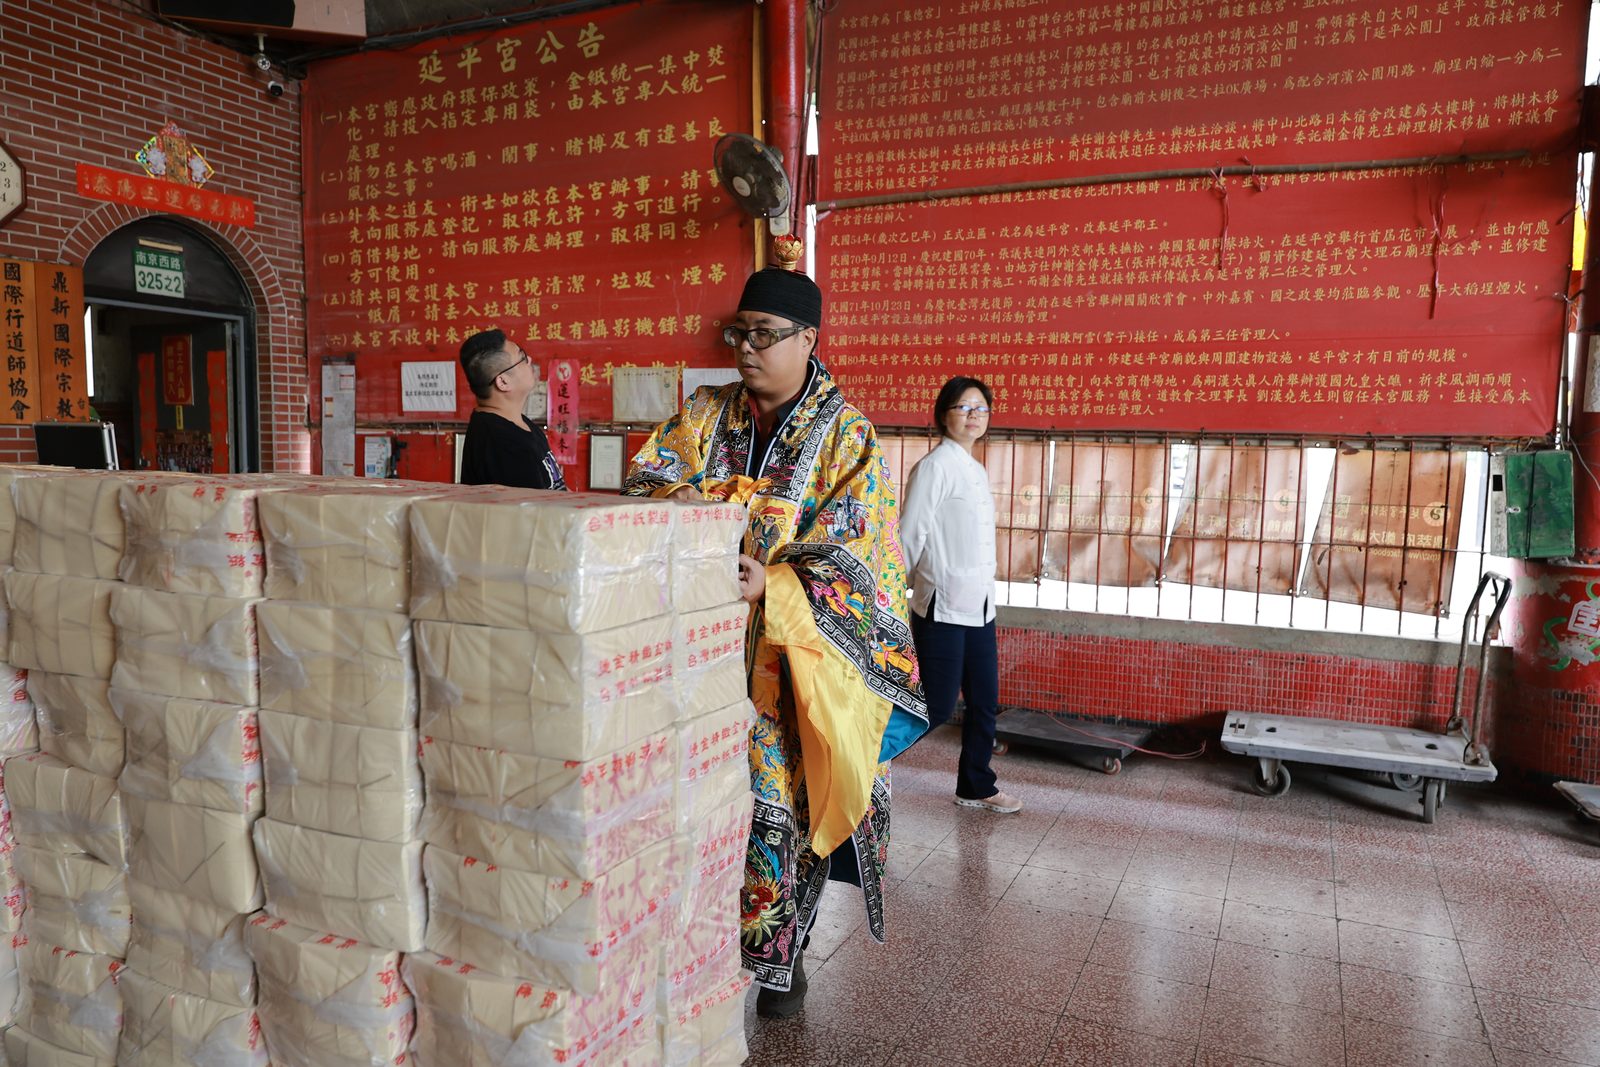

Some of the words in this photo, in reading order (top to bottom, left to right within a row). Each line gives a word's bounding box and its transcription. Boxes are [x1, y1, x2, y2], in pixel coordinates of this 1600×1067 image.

[418, 22, 605, 84] 延平宮公告
[135, 250, 181, 270] 南京西路
[138, 270, 182, 293] 325之2
[4, 262, 30, 420] 國際行道師協會
[51, 271, 77, 419] 鼎新國際宗教
